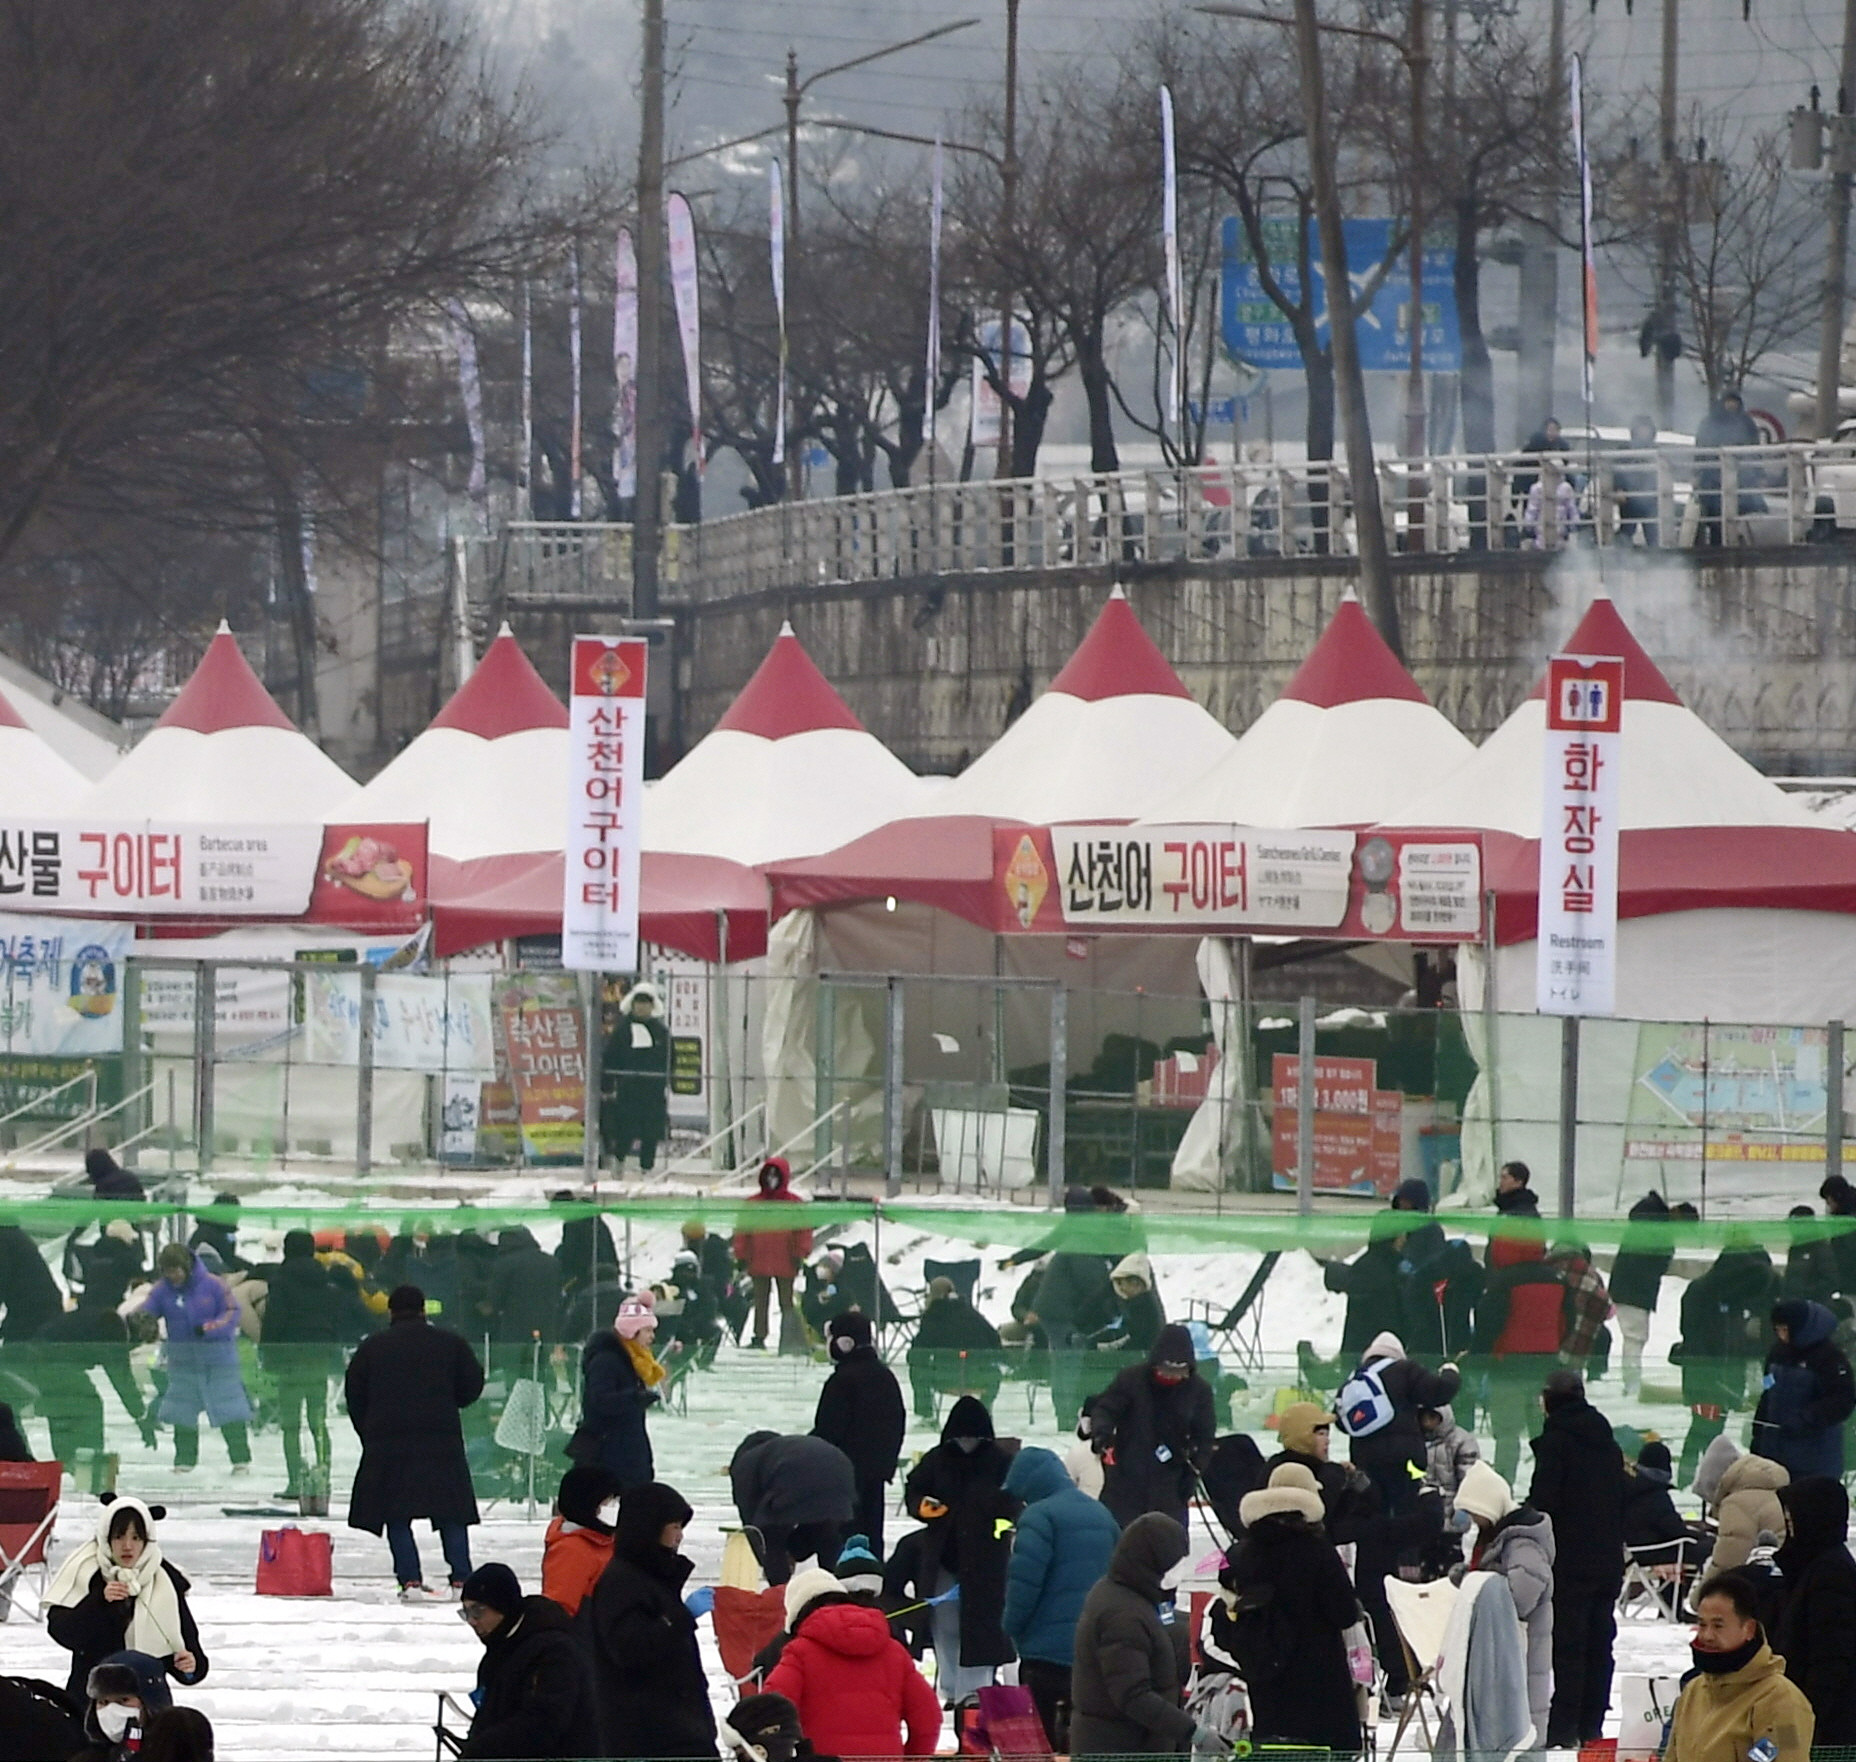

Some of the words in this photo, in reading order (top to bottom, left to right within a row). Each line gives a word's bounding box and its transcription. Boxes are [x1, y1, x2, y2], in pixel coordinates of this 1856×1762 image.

[1563, 742, 1604, 913] 화장실
[76, 832, 182, 899] 구이터
[1067, 842, 1151, 912] 산천어
[1163, 841, 1247, 912] 구이터
[1550, 933, 1605, 949] Restroom
[509, 1011, 579, 1049] 축산물
[520, 1053, 584, 1088] 구이터
